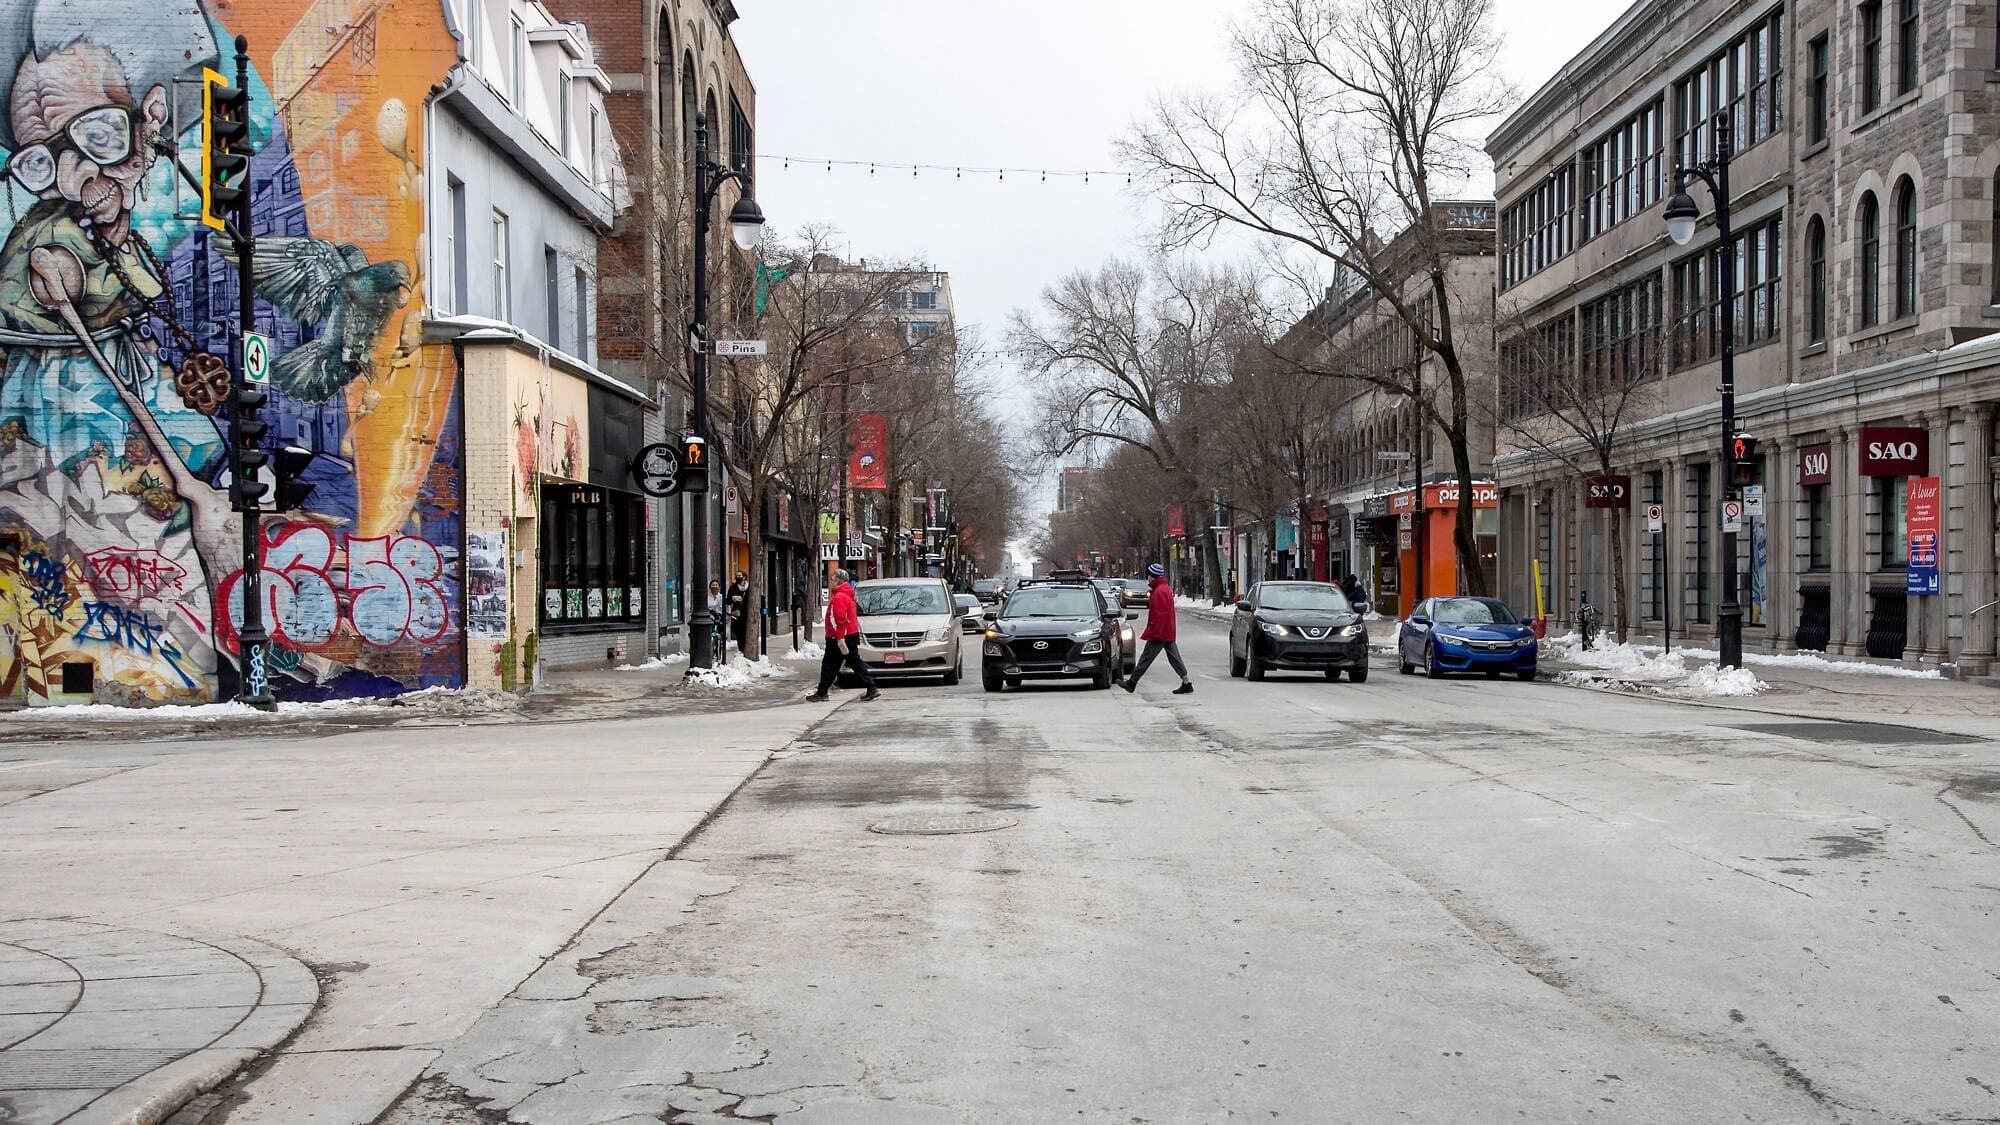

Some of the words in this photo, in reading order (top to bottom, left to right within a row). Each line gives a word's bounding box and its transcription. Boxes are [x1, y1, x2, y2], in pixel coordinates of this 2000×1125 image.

[732, 344, 756, 353] Pins
[1868, 441, 1918, 460] SAQ
[1805, 452, 1828, 476] SAQ
[571, 492, 600, 504] PUB
[1440, 489, 1479, 504] piza
[1917, 483, 1937, 499] louer
